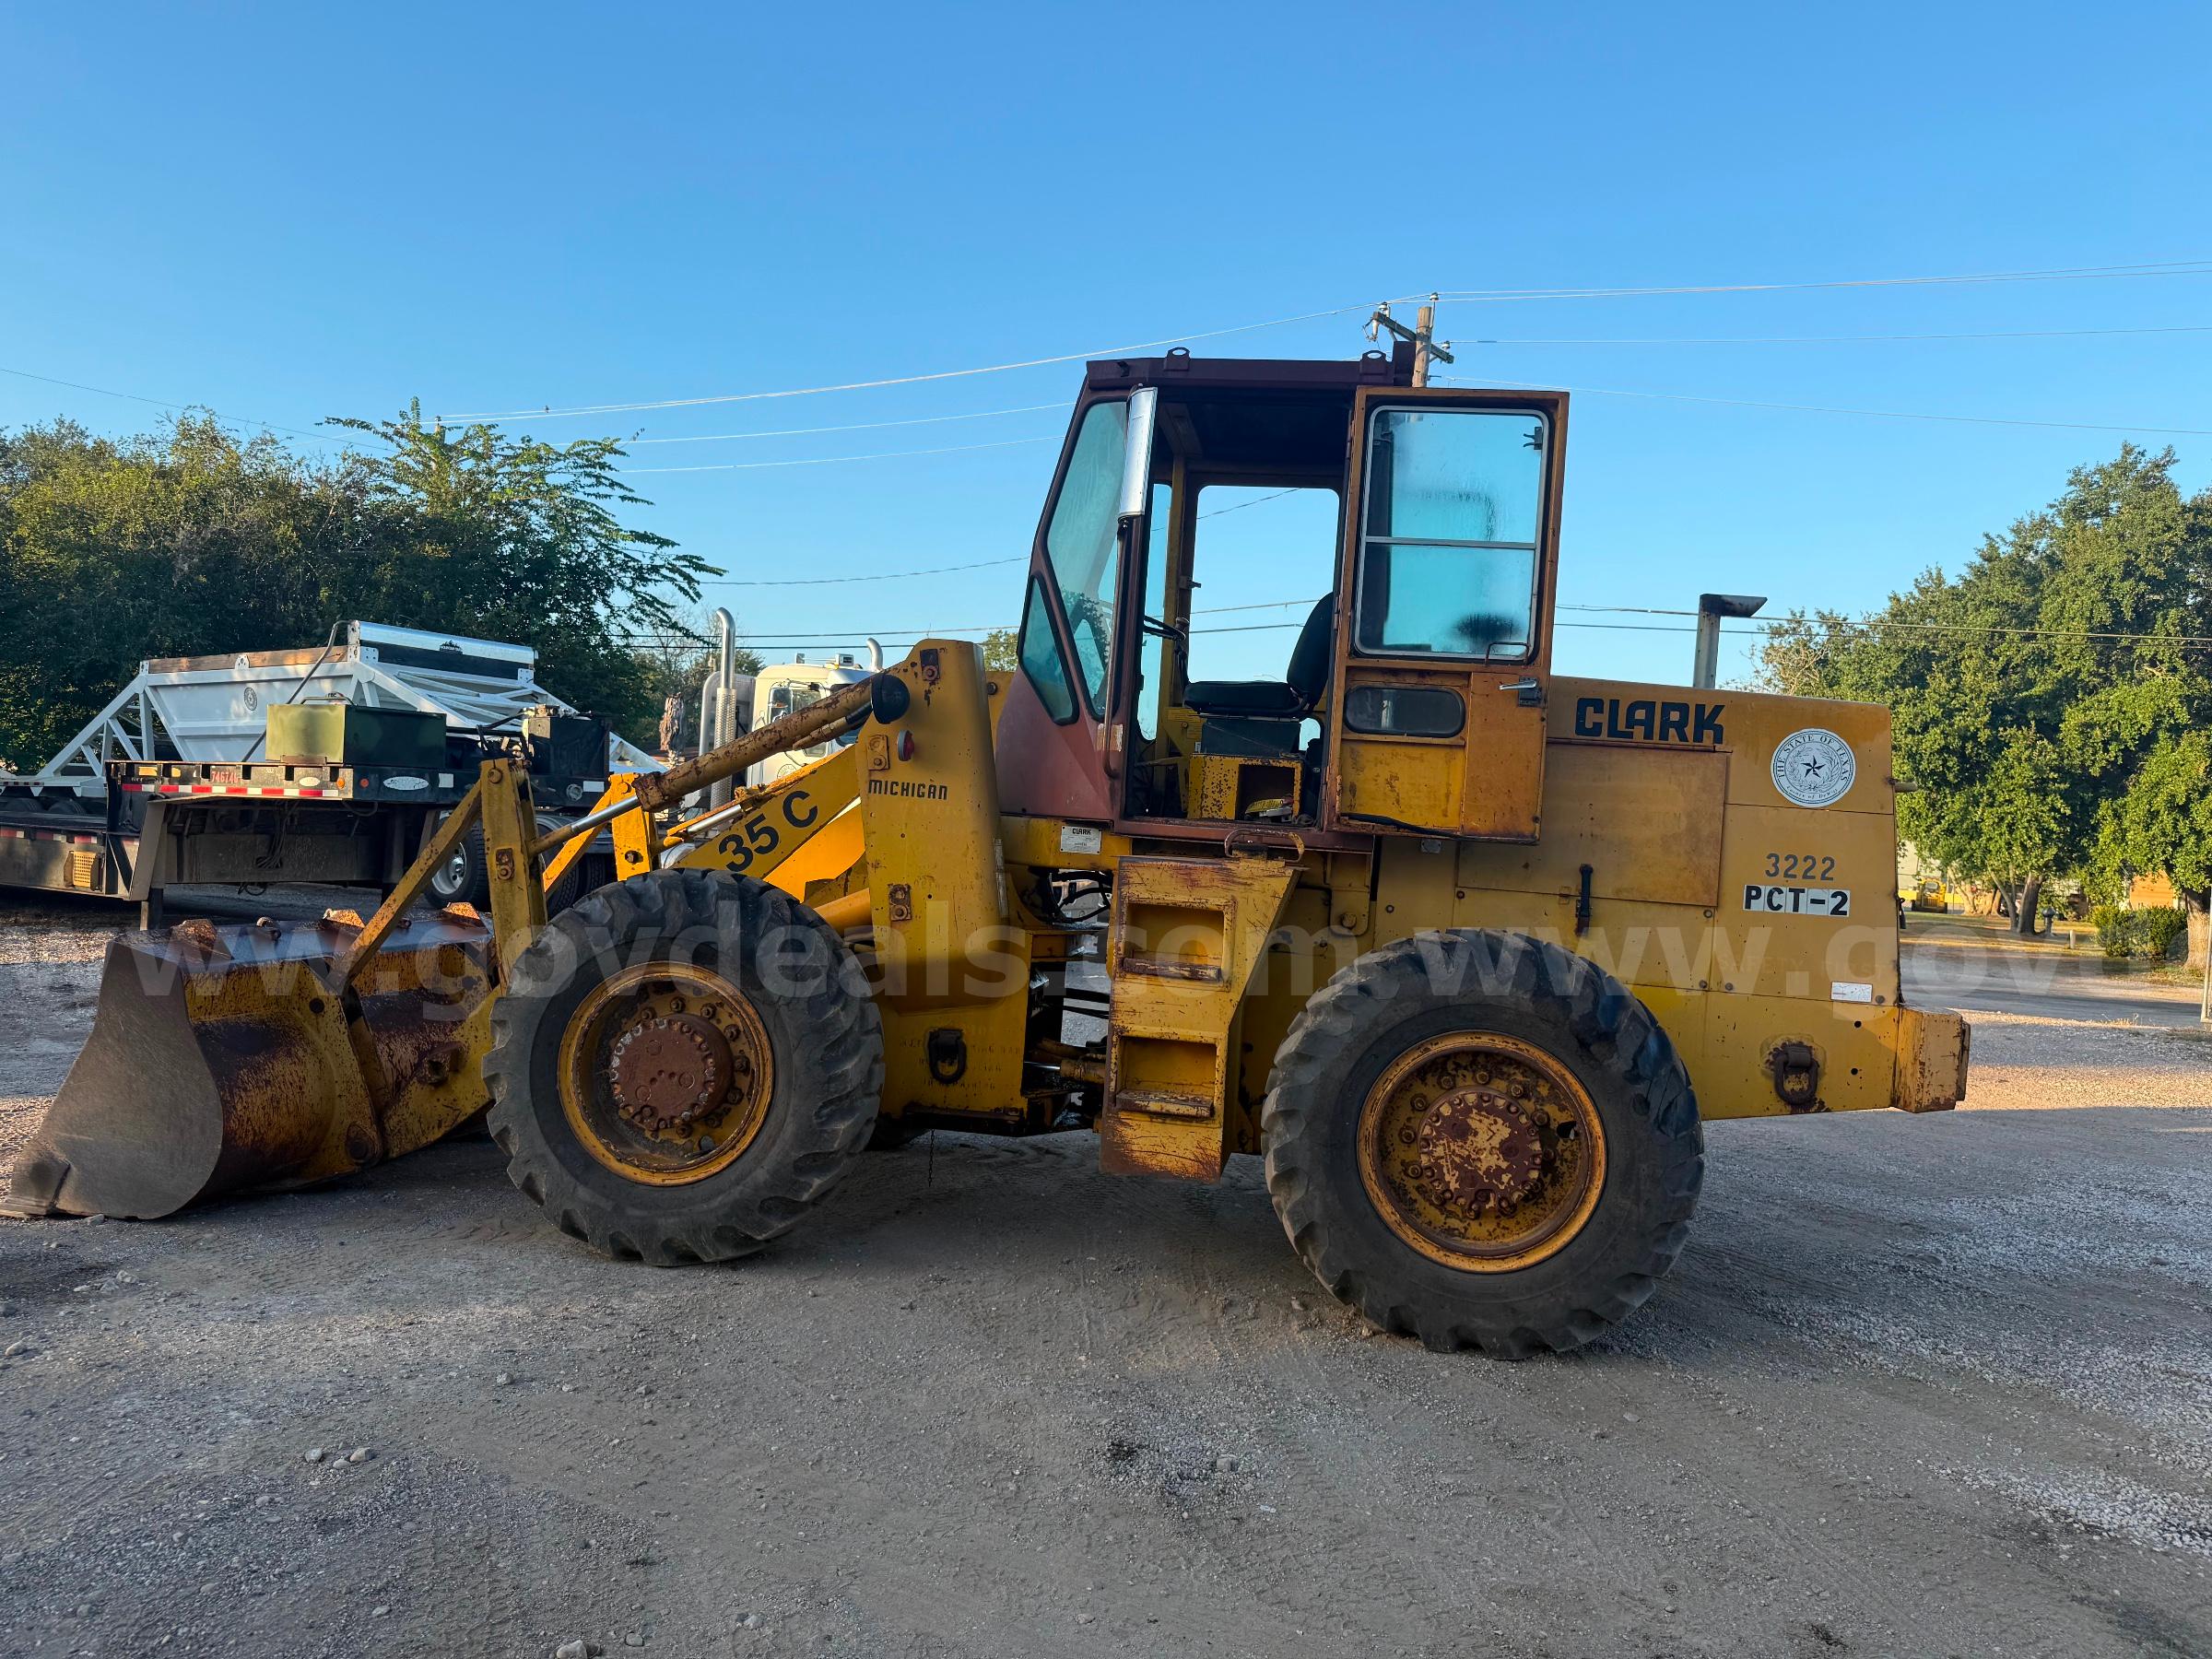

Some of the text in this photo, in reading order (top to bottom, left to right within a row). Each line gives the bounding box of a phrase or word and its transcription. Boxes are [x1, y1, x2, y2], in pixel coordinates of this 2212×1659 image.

[1575, 698, 1725, 745] CLARK
[1777, 735, 1850, 782] THE STATE OF TEXAS
[868, 779, 947, 800] MICHIGAN
[719, 790, 818, 872] 35 C
[1765, 853, 1835, 880] 3222
[1745, 885, 1848, 915] PCT-2
